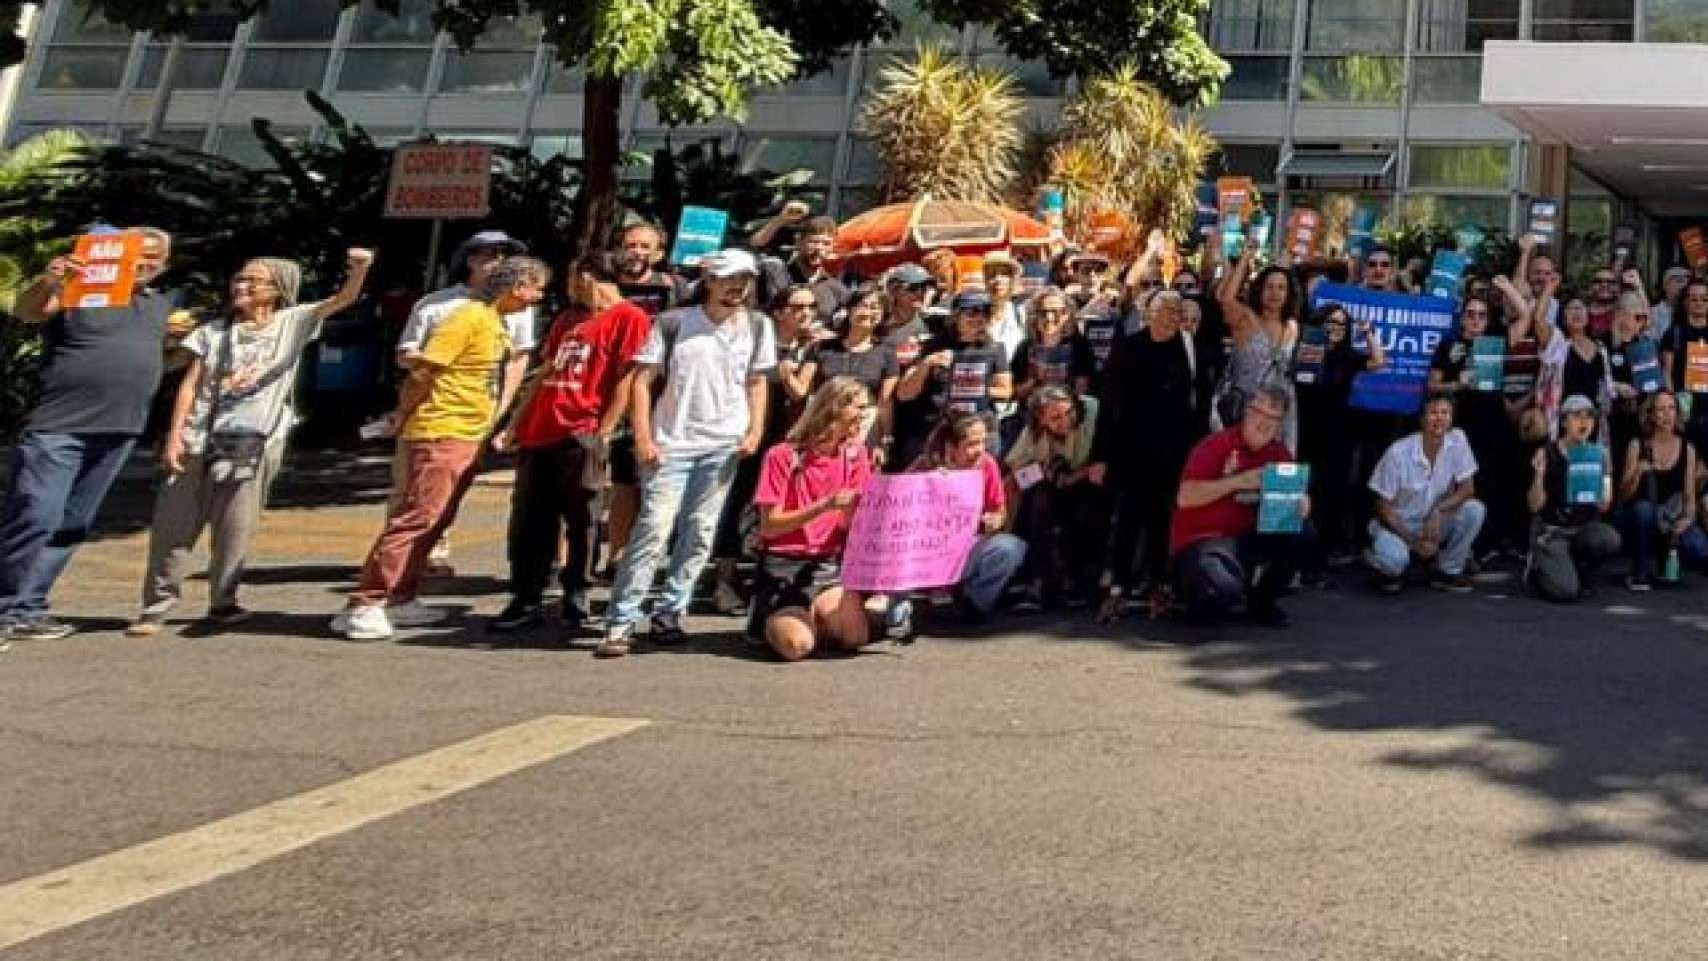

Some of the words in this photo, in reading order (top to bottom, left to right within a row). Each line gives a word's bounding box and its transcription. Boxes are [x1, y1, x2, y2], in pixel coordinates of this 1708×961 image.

[403, 149, 459, 173] CORPO
[463, 148, 486, 173] DE
[393, 186, 483, 208] BOMBEIROS
